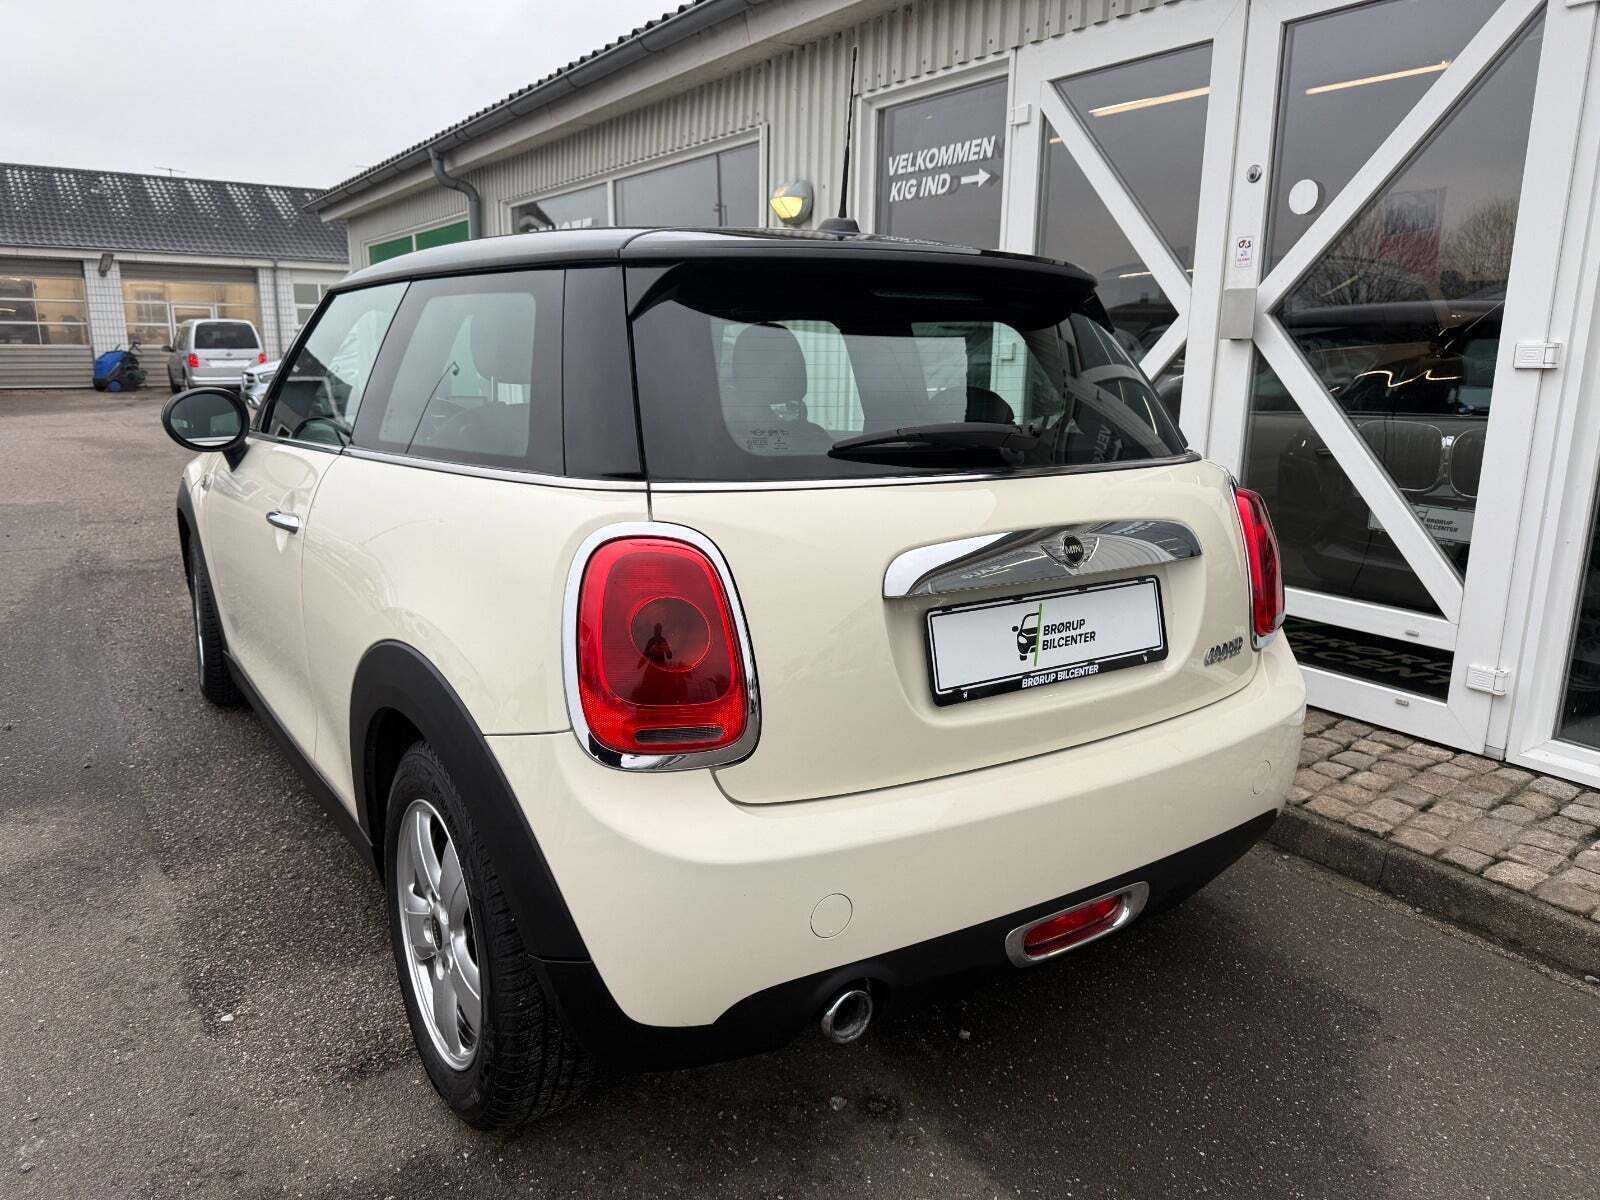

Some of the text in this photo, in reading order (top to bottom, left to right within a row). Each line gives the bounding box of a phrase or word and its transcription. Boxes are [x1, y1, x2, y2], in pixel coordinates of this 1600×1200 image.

[888, 136, 995, 176] VELKOMMEN
[889, 173, 950, 202] KIG IND
[1043, 618, 1086, 636] BRØRUP
[1042, 631, 1096, 651] BILCENTER
[1022, 665, 1099, 688] BRØRUP BILCENTER
